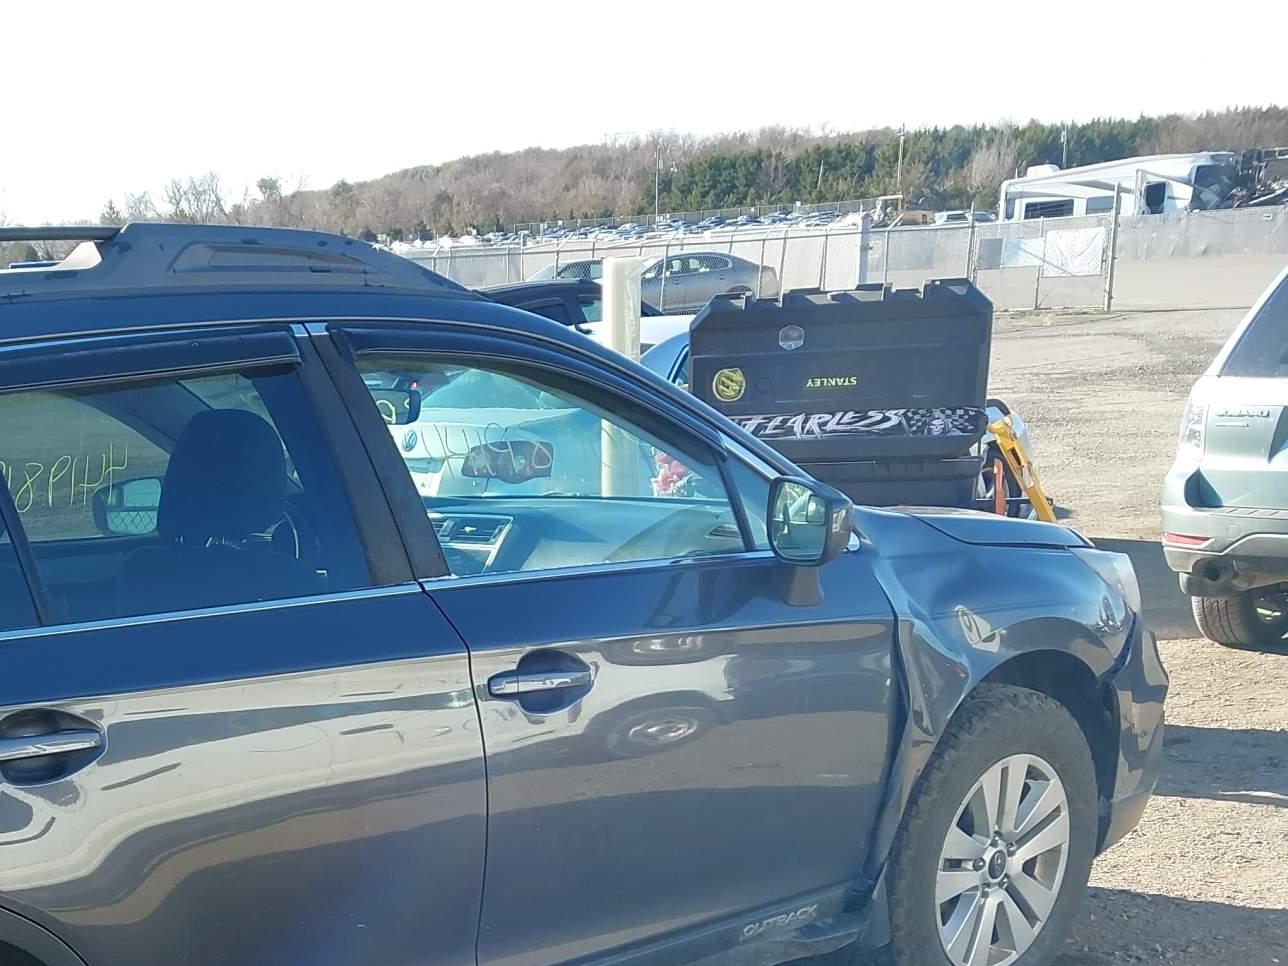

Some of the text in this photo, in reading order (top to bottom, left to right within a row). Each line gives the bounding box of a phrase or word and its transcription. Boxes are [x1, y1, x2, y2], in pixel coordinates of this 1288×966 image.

[805, 376, 857, 388] STANLEY
[740, 408, 907, 440] FEARLESS
[743, 904, 818, 937] OUTBACK
